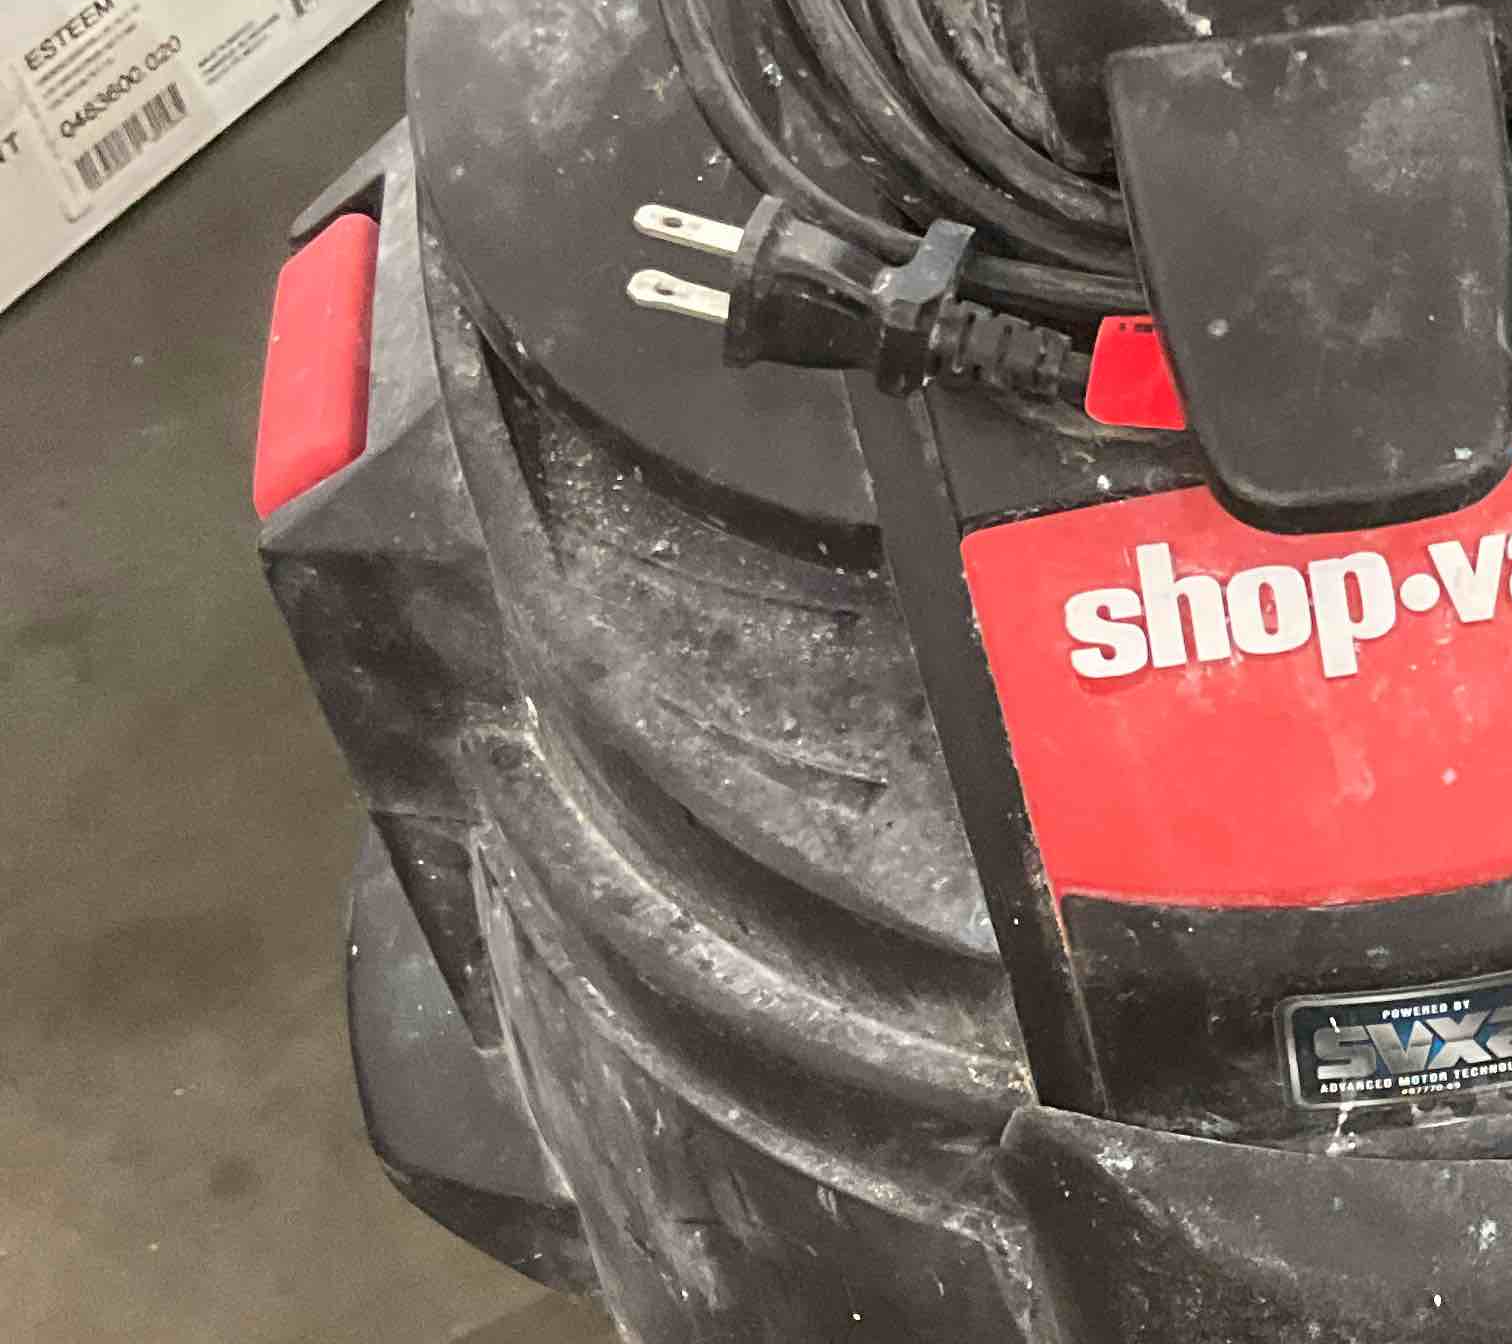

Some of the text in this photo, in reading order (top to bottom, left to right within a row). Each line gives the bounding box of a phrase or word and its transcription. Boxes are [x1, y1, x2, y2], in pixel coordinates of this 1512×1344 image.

[1382, 999, 1471, 1020] POWERED BY
[1320, 1077, 1393, 1094] ADVANCED
[1399, 1071, 1449, 1087] MOTOR
